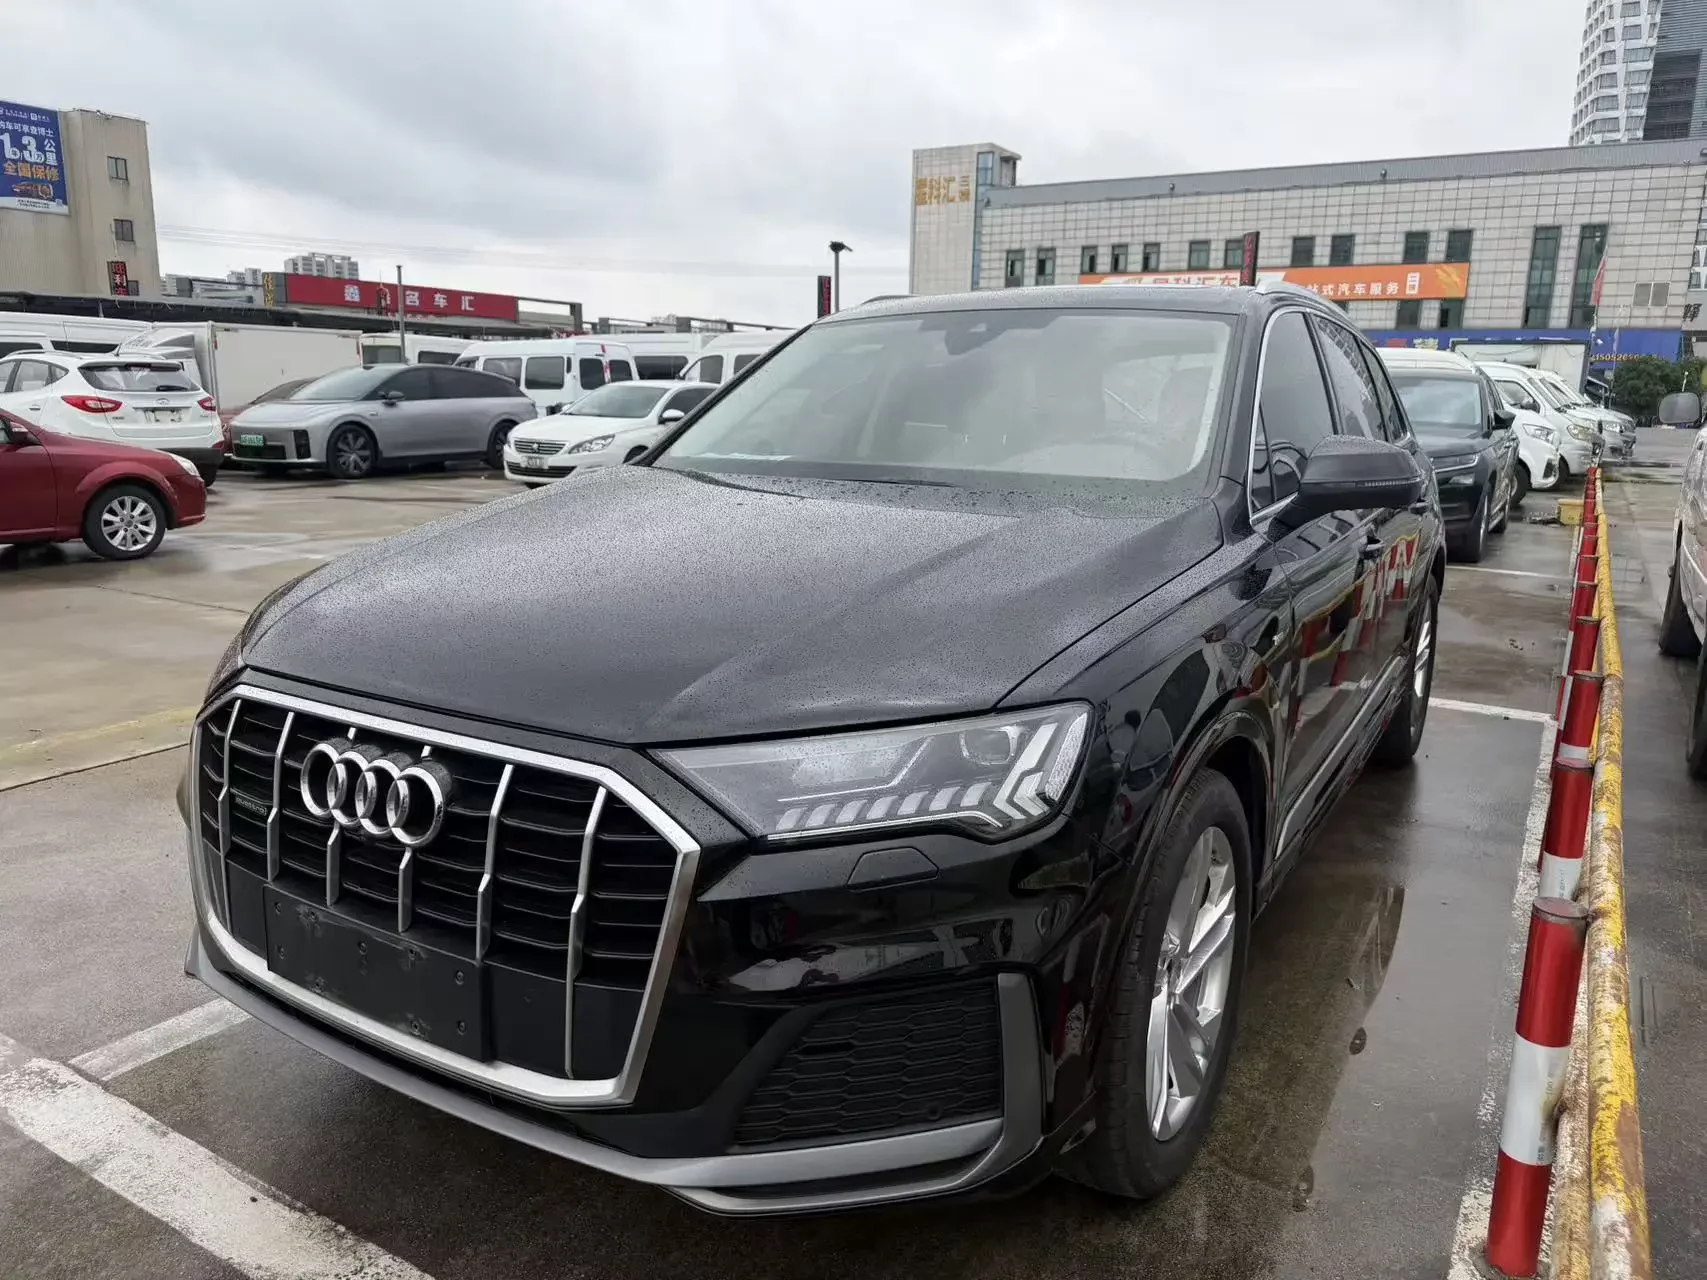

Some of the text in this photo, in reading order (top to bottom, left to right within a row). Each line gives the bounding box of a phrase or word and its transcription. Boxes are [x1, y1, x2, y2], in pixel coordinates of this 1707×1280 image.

[4, 160, 59, 182] 全国保修
[1302, 282, 1400, 295] 站式汽车服务
